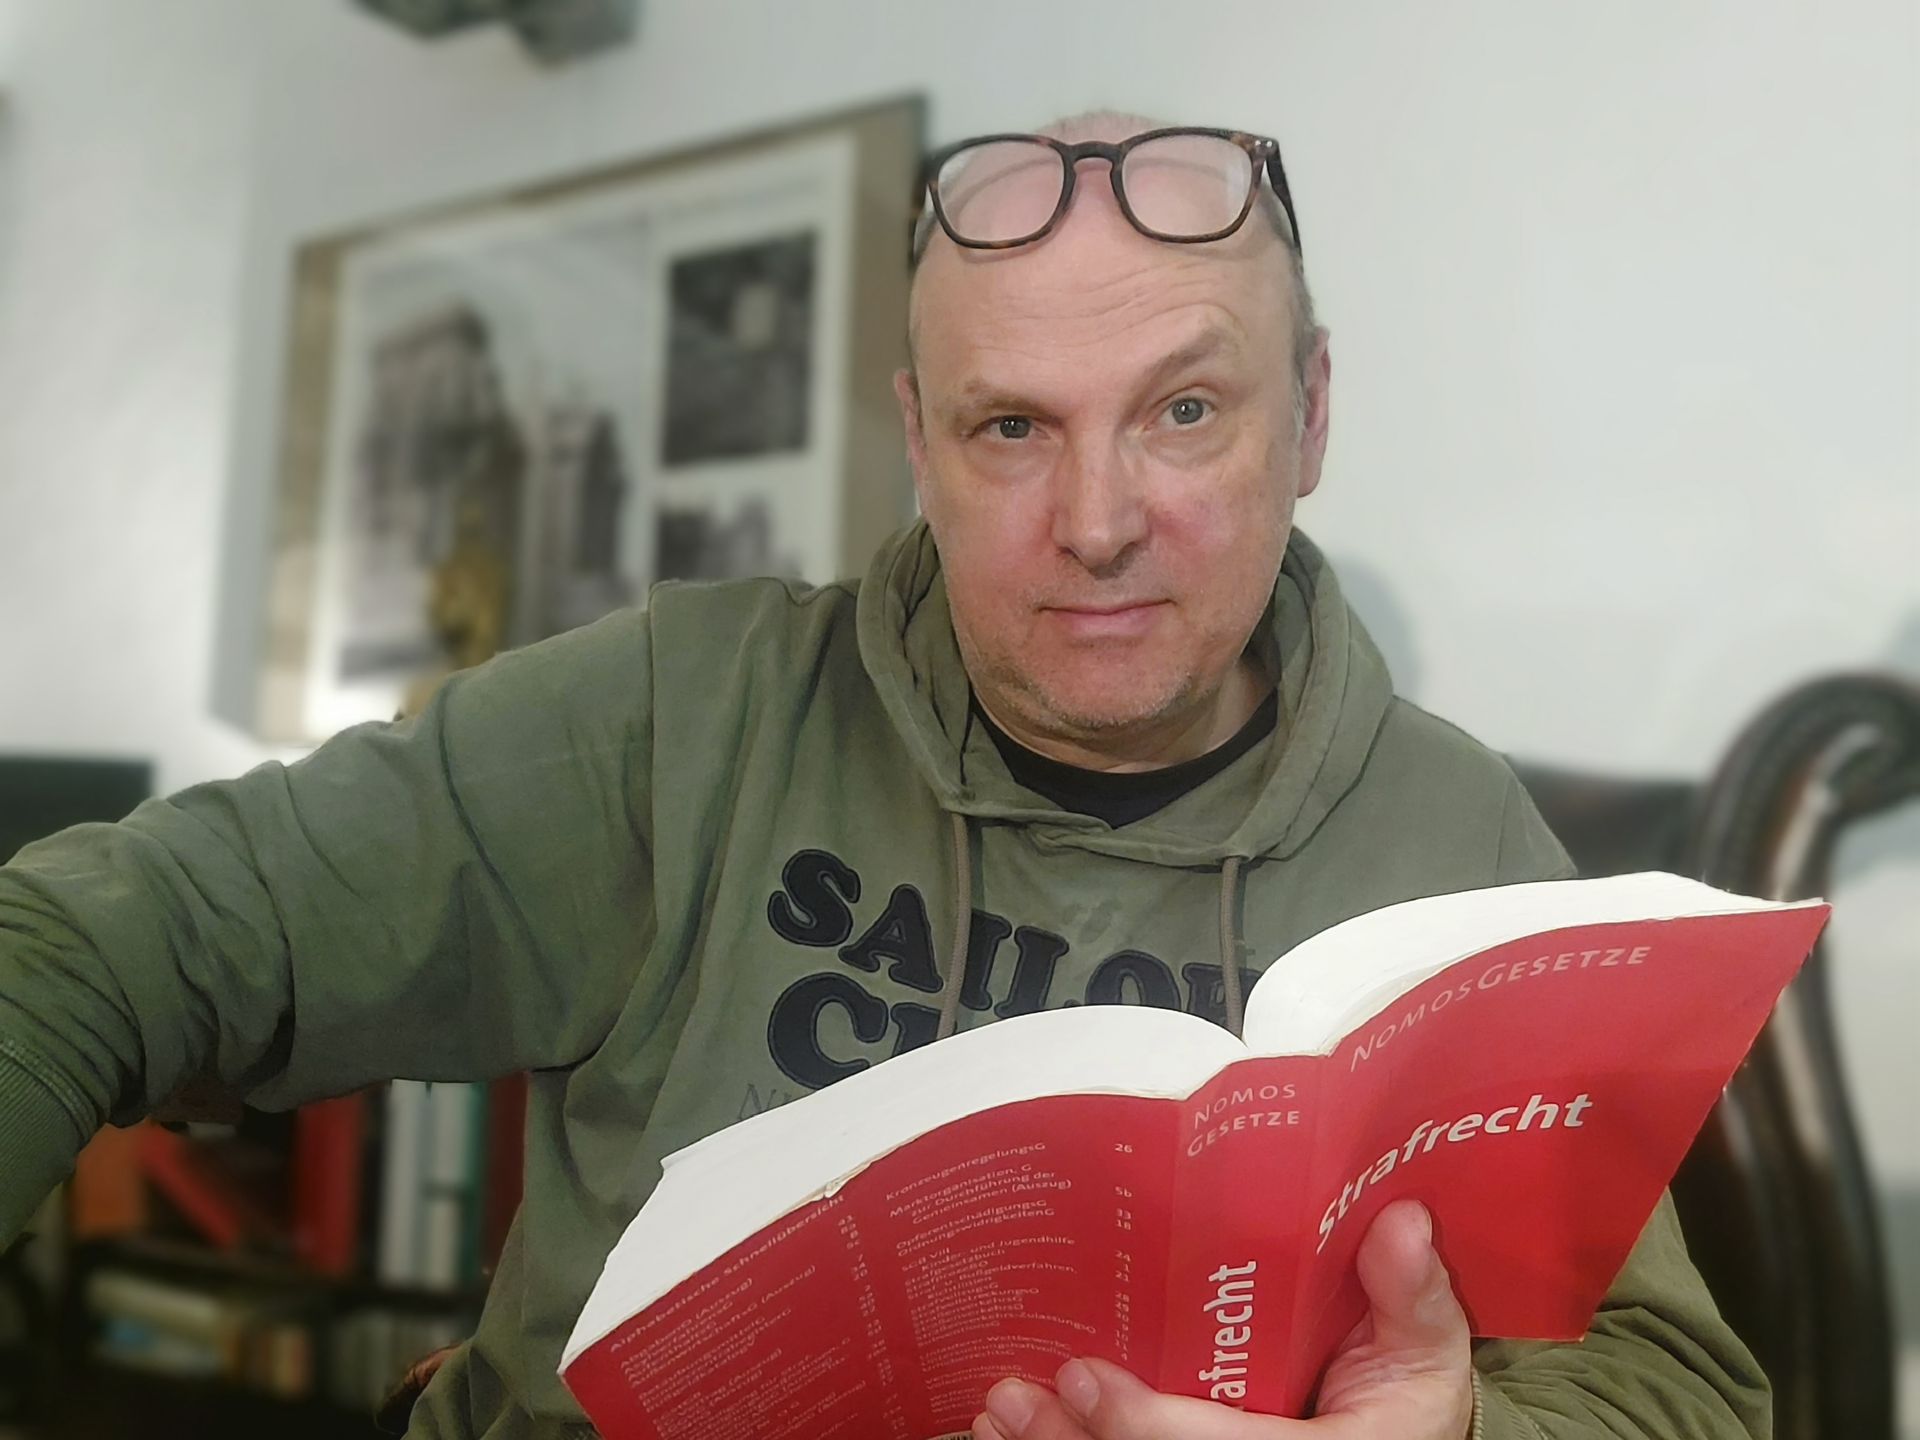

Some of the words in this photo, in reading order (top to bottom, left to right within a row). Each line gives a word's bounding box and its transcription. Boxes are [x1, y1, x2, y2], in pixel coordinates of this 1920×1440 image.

[1194, 1083, 1296, 1130] NOMOS
[1114, 1143, 1133, 1153] 26
[1187, 1110, 1300, 1157] GESETZE
[1316, 1093, 1593, 1254] Strafrecht
[1198, 1261, 1257, 1406] afrecht
